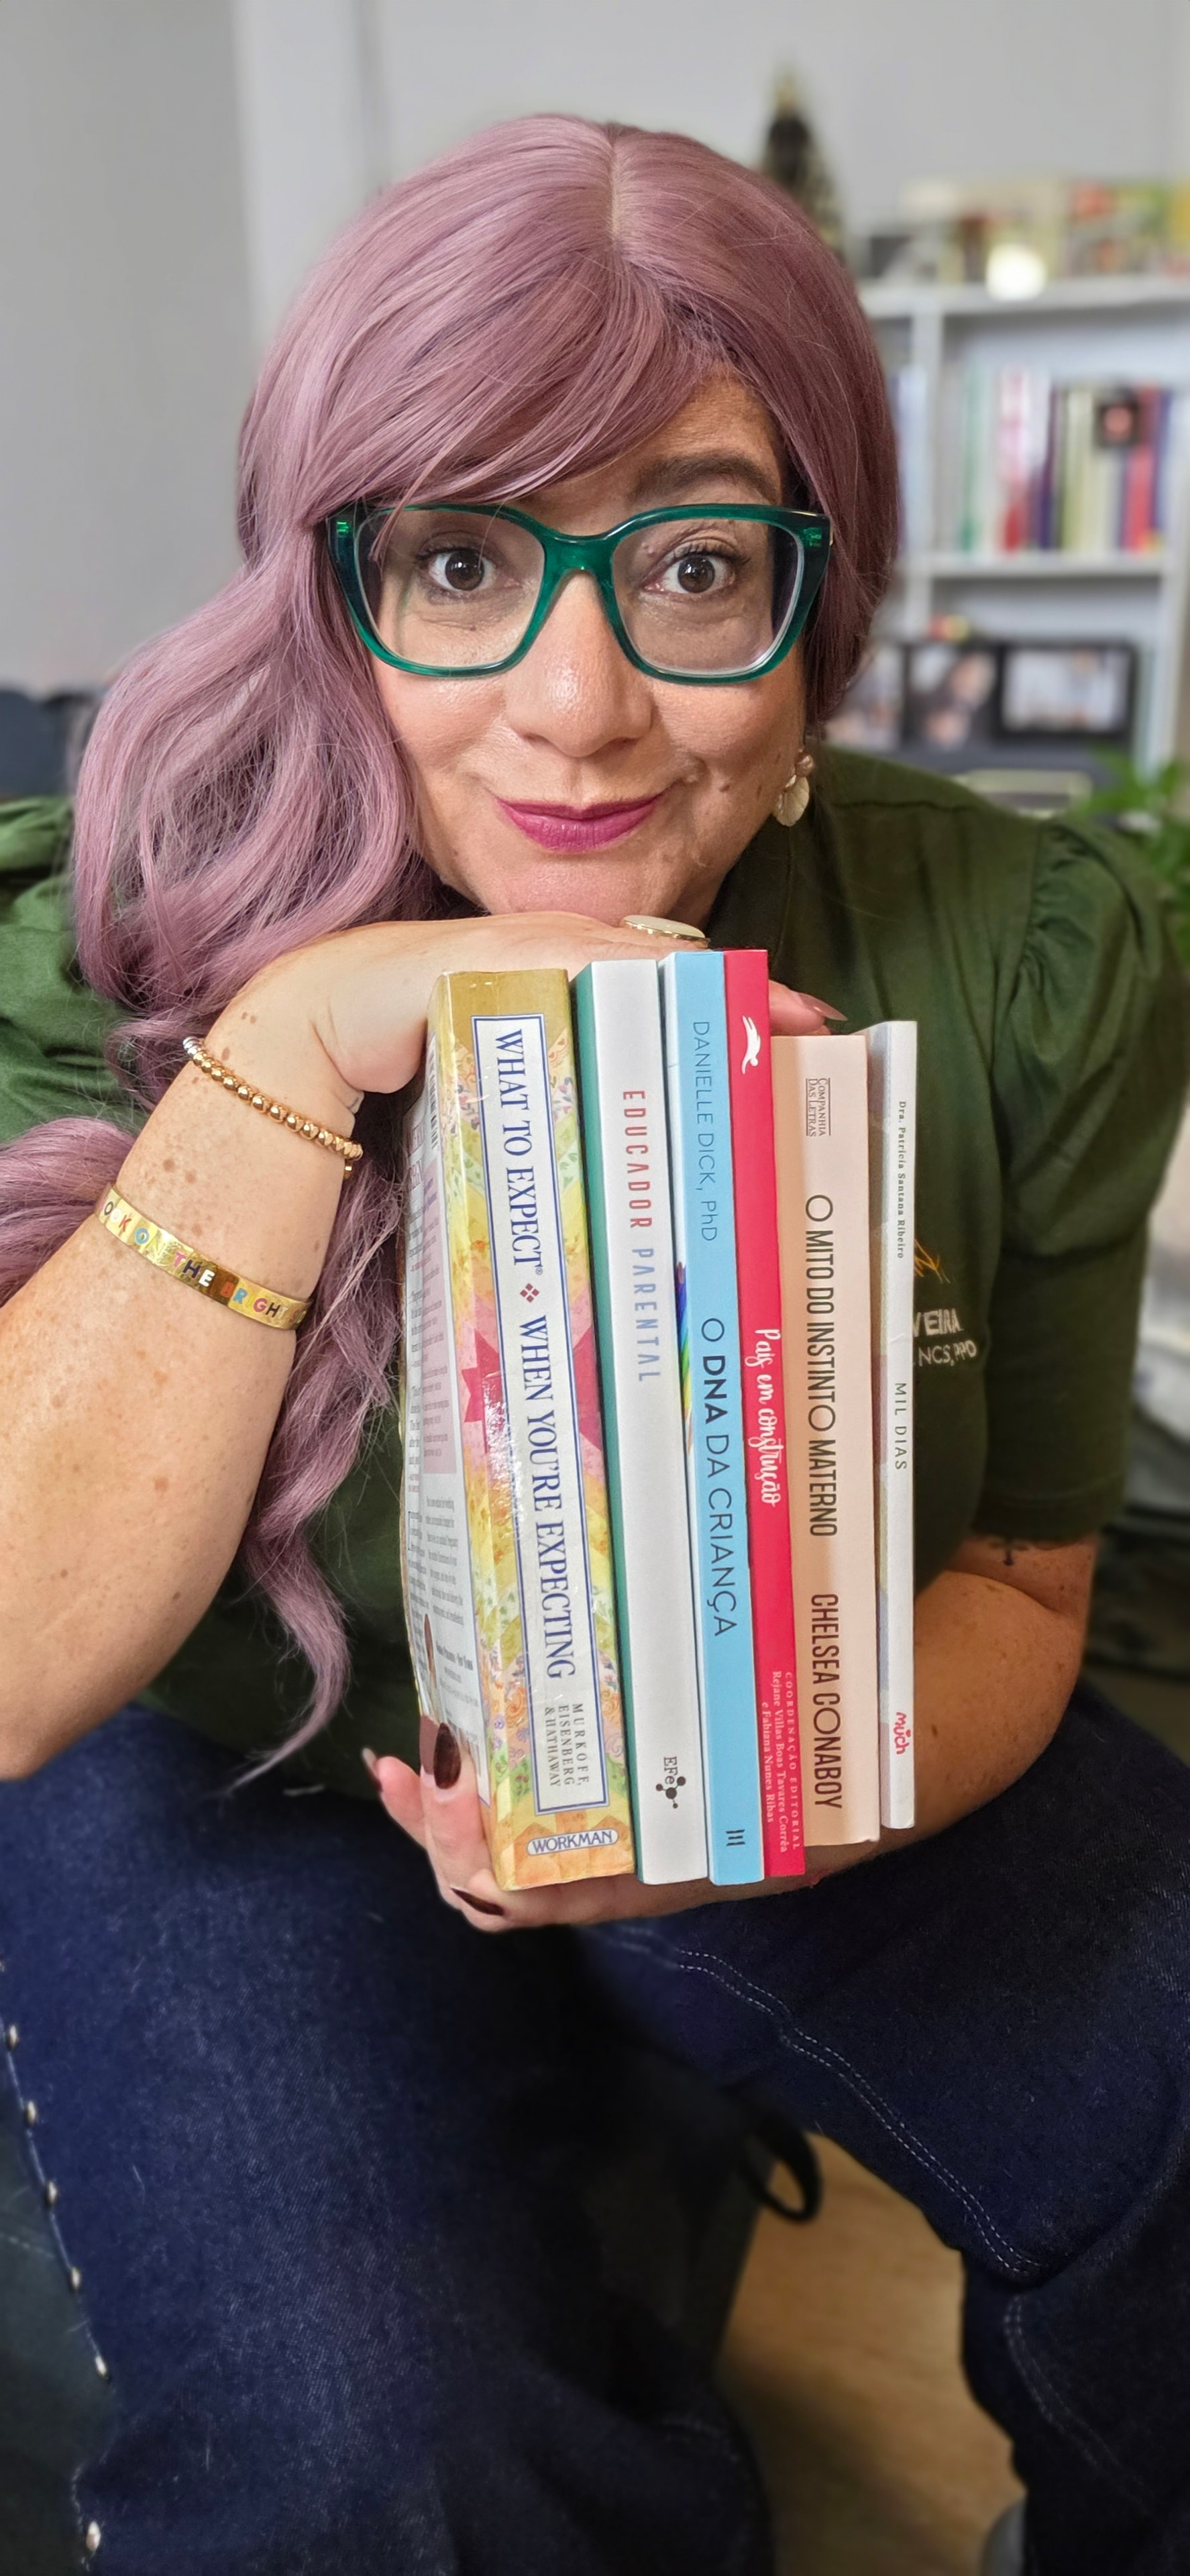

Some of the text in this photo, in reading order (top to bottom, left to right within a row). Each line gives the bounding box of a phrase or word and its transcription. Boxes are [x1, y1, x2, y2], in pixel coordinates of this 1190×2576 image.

[495, 1028, 531, 1110] WHAT
[808, 1078, 820, 1137] DAS LETRAS
[818, 1077, 828, 1136] COMPANHIA
[502, 1120, 533, 1157] TO
[693, 1022, 718, 1241] DANIELLE DICK, PhD
[898, 1101, 906, 1122] Dra.
[898, 1173, 906, 1216] Santana
[172, 1251, 215, 1287] THE
[623, 1090, 661, 1382] EDUCADOR PARENTAL
[897, 1220, 906, 1258] Ribeiro
[519, 1314, 555, 1401] WHEN
[805, 1194, 838, 1537] O MITO DO INSTINTO MATERNO
[745, 1329, 784, 1507] Pais em construção
[894, 1383, 908, 1470] MIL DIAS
[527, 1409, 563, 1512] YOU'RE
[701, 1318, 738, 1637] O DNA DA CRIANÇA
[536, 1520, 576, 1679] EXPECTING
[762, 1711, 772, 1752] Fabiana
[811, 1594, 843, 1809] CHELSEA CONABOY
[558, 1705, 575, 1785] EISENBERG
[572, 1703, 590, 1785] MURKOFF,
[764, 1755, 773, 1790] Nunes
[771, 1671, 790, 1853] Rejane Villas Boas Tavares Corrêa
[785, 1672, 800, 1850] COORDENAÇÃO EDITORIAL
[532, 1830, 613, 1854] WORKMAN
[765, 1793, 775, 1823] Ribas
